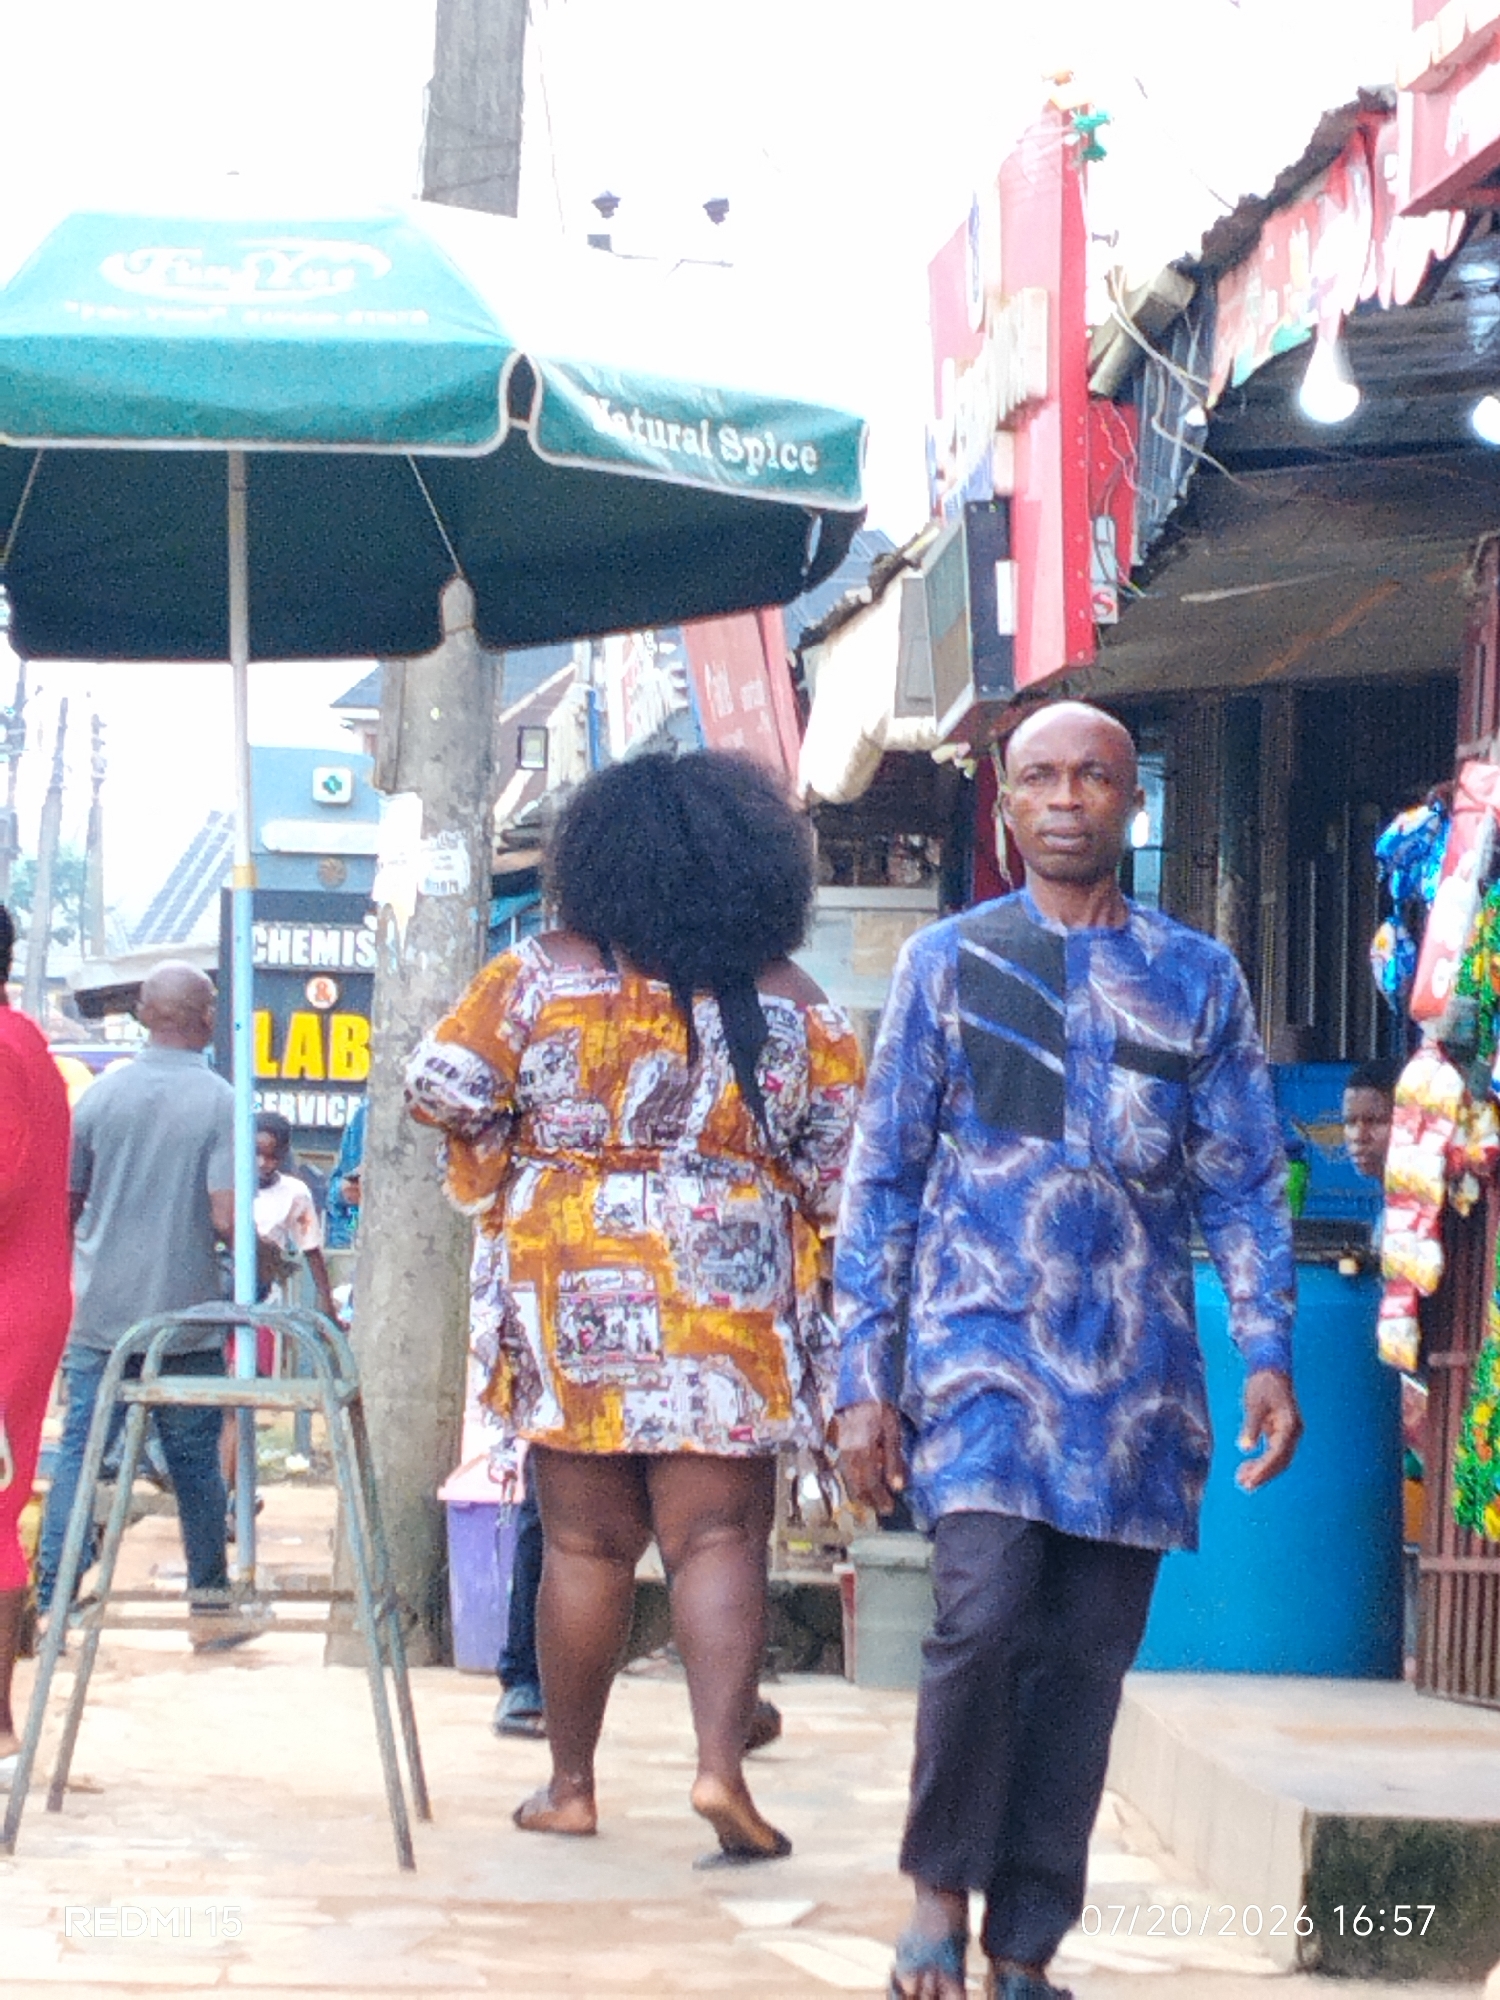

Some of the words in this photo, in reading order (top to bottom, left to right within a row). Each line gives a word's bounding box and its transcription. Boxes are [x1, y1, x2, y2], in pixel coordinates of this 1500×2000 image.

[588, 397, 713, 458] Natural
[718, 422, 819, 475] Spice
[253, 1009, 371, 1081] LAB
